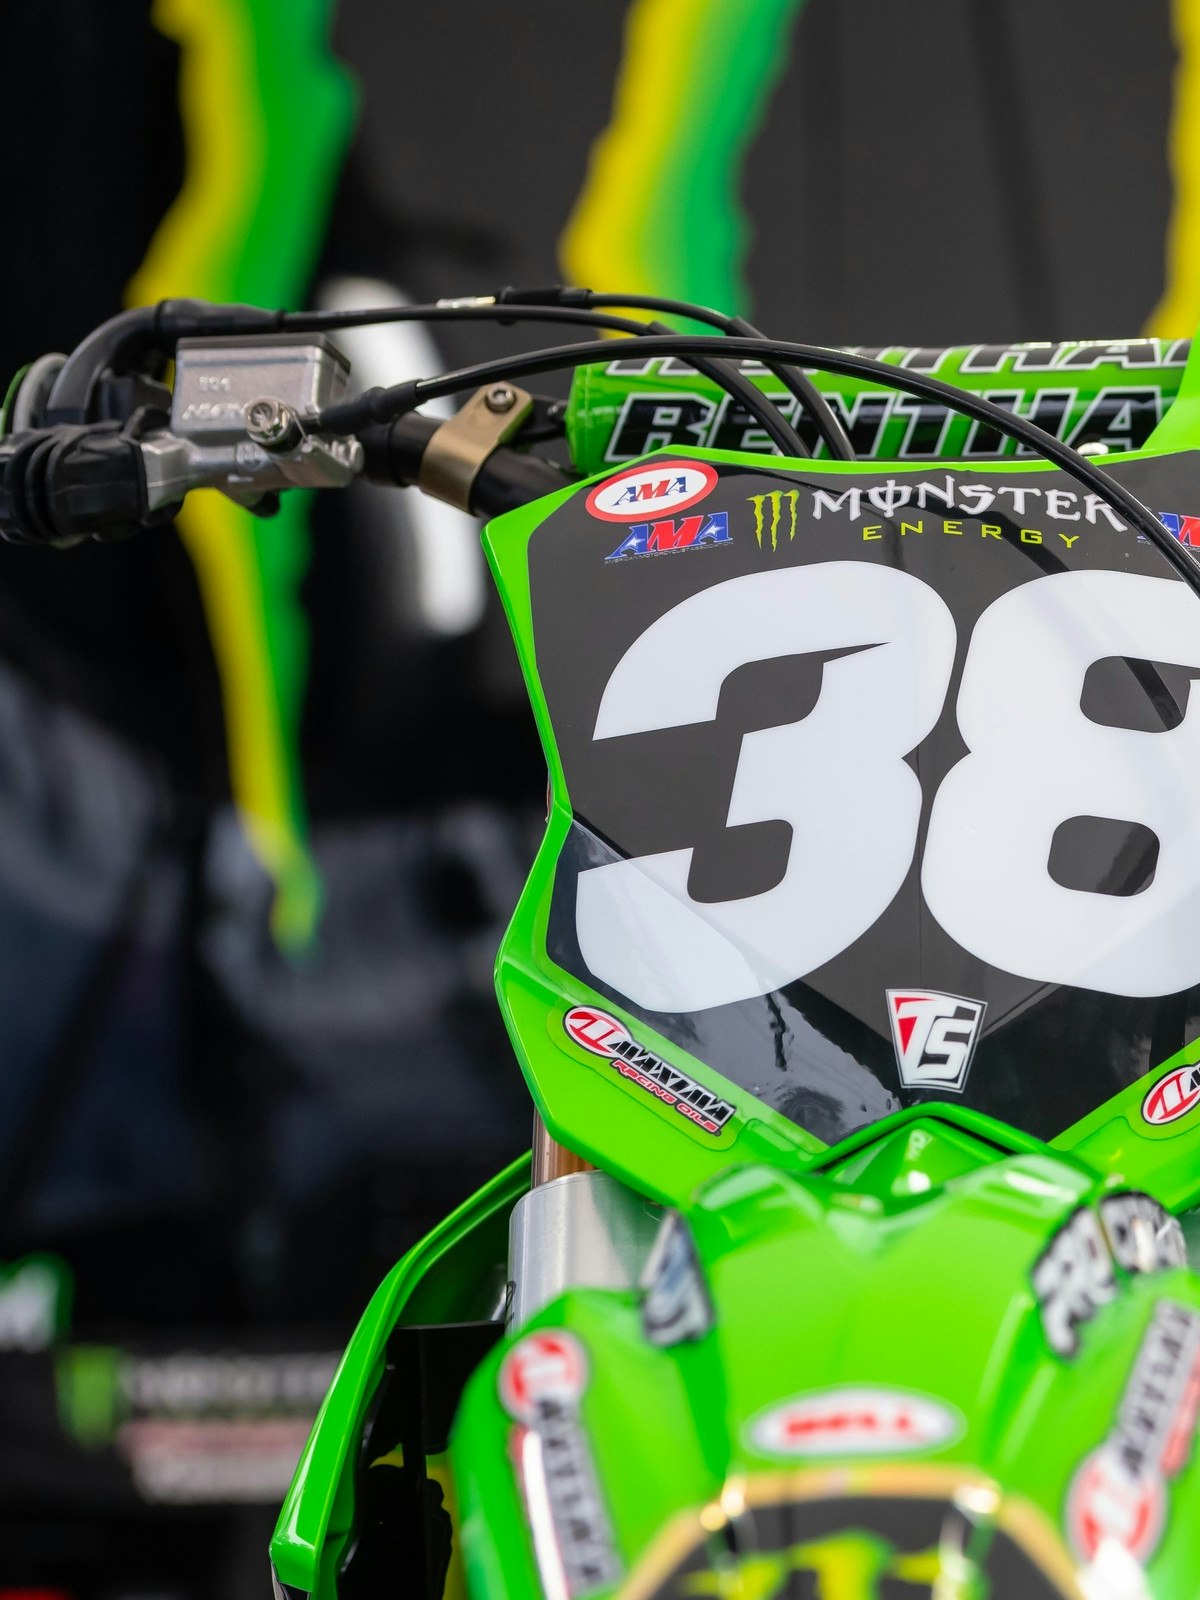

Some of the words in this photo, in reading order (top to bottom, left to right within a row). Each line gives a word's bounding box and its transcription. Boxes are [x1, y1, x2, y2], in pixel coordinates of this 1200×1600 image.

[612, 476, 687, 506] AMA
[812, 475, 1128, 532] MONSTER
[604, 511, 733, 560] AMA
[862, 520, 1080, 548] ENERGY
[890, 992, 980, 1087] TS
[606, 1039, 736, 1126] MAXIMA
[612, 1058, 678, 1105] RACING
[677, 1103, 720, 1133] OILS
